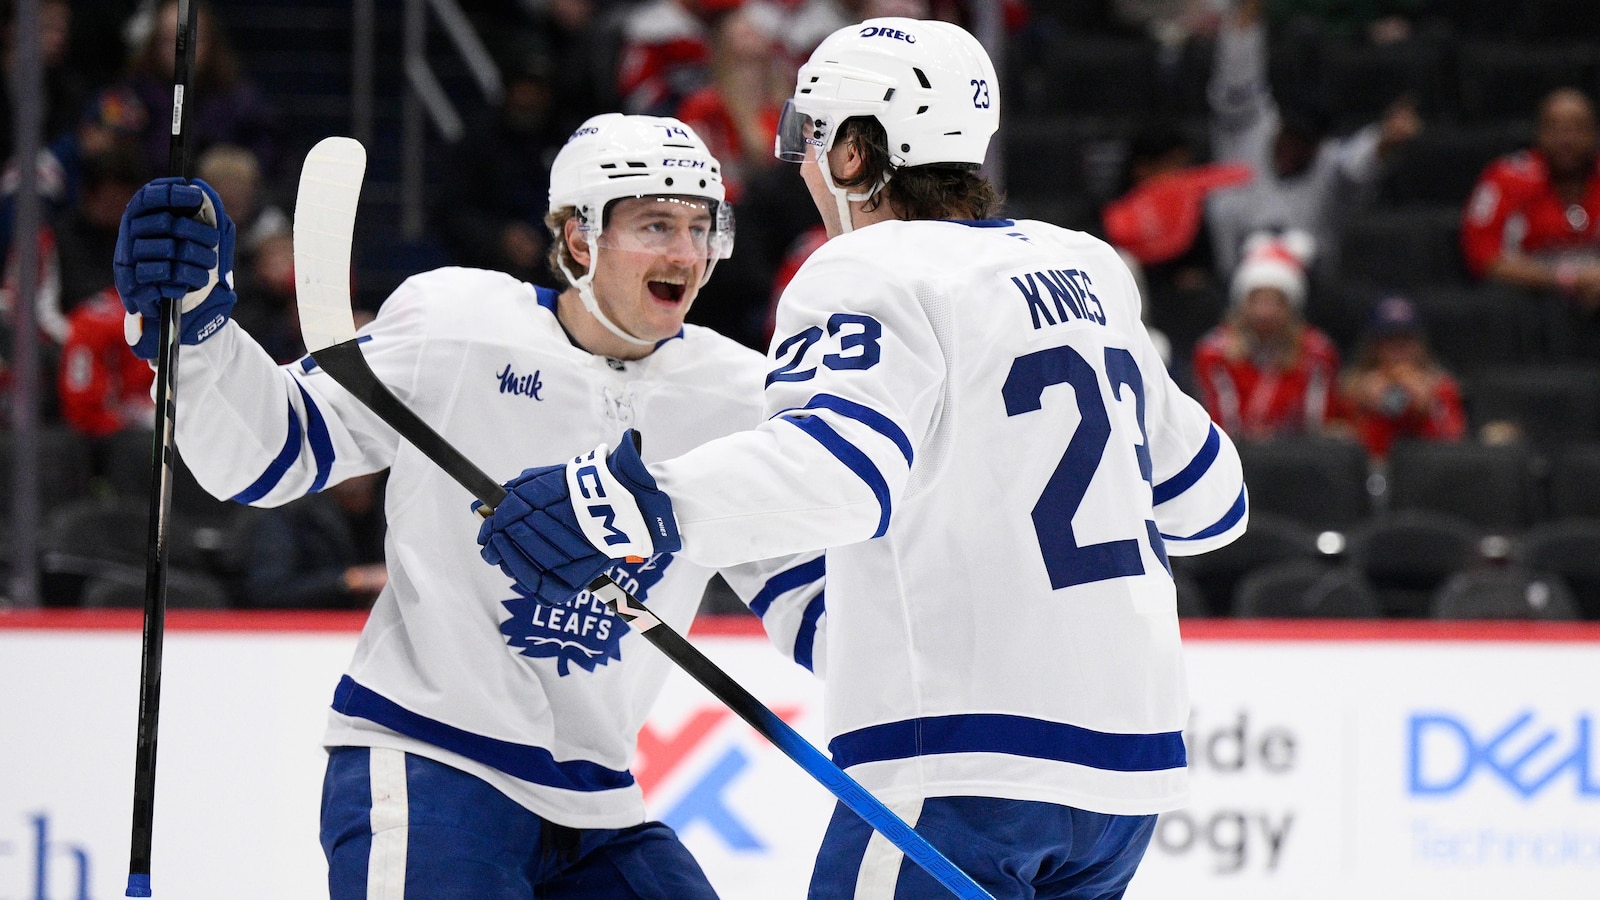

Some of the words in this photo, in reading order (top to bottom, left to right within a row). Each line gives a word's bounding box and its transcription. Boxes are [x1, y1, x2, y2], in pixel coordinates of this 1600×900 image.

[970, 79, 990, 109] 23
[653, 125, 689, 139] 74
[662, 158, 706, 169] CCM
[1011, 268, 1107, 330] KNIES
[197, 314, 225, 341] CCM
[765, 313, 882, 390] 23
[496, 363, 544, 401] Milk
[532, 604, 612, 641] LEAFS
[820, 773, 991, 900] JETSPEE
